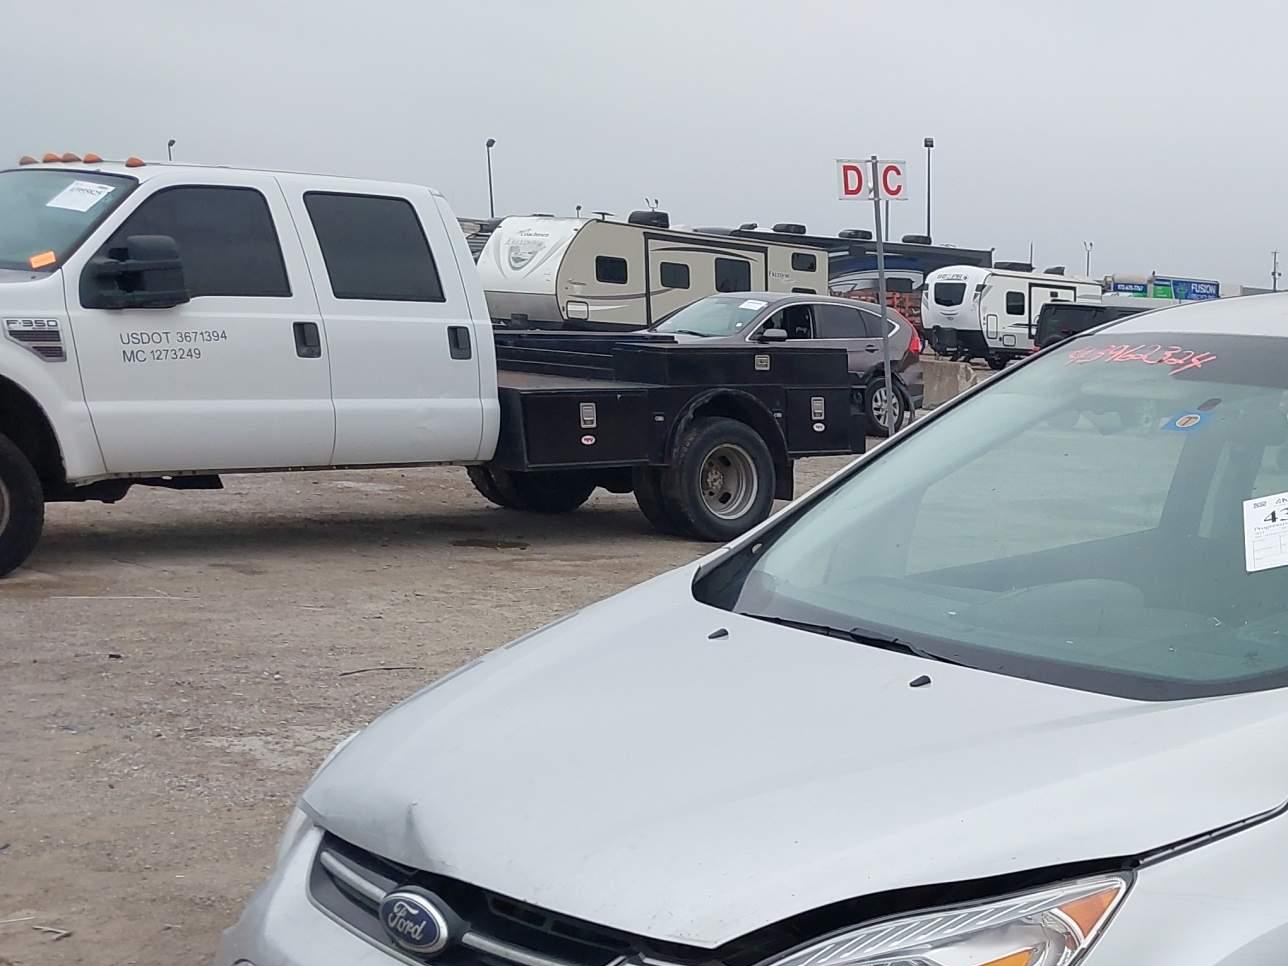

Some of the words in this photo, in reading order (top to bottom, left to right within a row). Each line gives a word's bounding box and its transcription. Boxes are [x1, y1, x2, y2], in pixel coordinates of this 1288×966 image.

[842, 165, 863, 195] D
[882, 165, 902, 196] C
[1190, 283, 1217, 294] FUSION
[6, 319, 58, 328] F-350
[120, 331, 171, 345] USDOT
[176, 330, 227, 343] 3671394
[122, 349, 147, 362] MC
[150, 347, 201, 361] 1273249
[388, 901, 428, 940] Ford
